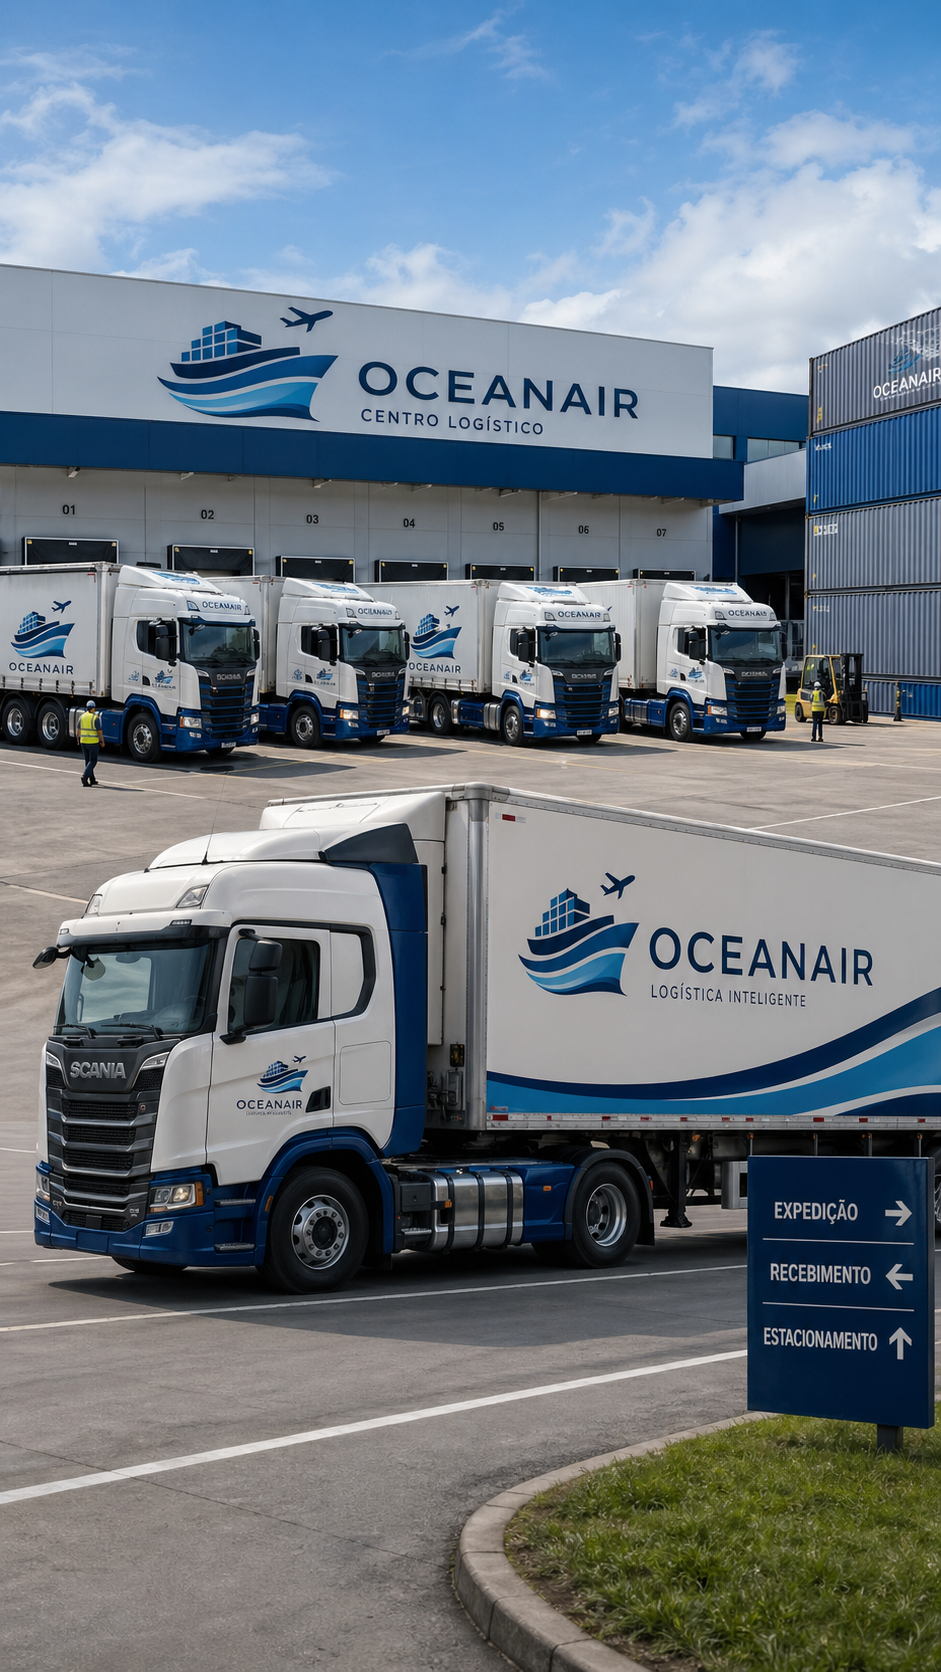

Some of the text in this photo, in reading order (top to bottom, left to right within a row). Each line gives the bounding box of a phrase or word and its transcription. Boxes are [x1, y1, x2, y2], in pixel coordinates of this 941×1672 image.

[873, 367, 941, 399] OCEANAIR
[358, 361, 639, 419] OCEANAIR
[360, 408, 544, 435] CENTRO LOGÍSTICO
[62, 504, 76, 516] 01
[200, 509, 215, 520] 02
[306, 514, 319, 525] 03
[403, 518, 416, 529] 04
[492, 521, 505, 532] 05
[578, 524, 590, 535] 06
[656, 528, 667, 538] 07
[9, 662, 74, 675] OCEANAIR
[408, 661, 462, 674] OCEANAIR
[649, 926, 873, 986] OCEANAIR
[651, 982, 806, 1007] LOGÍSTICA INTELIGENTE
[70, 1061, 127, 1079] SCANIA
[236, 1099, 303, 1110] OCEANAIR
[774, 1199, 859, 1225] EXPEDIÇÃO
[770, 1263, 872, 1285] RECEBIMENTO
[763, 1327, 878, 1351] ESTACIONAMENTO
